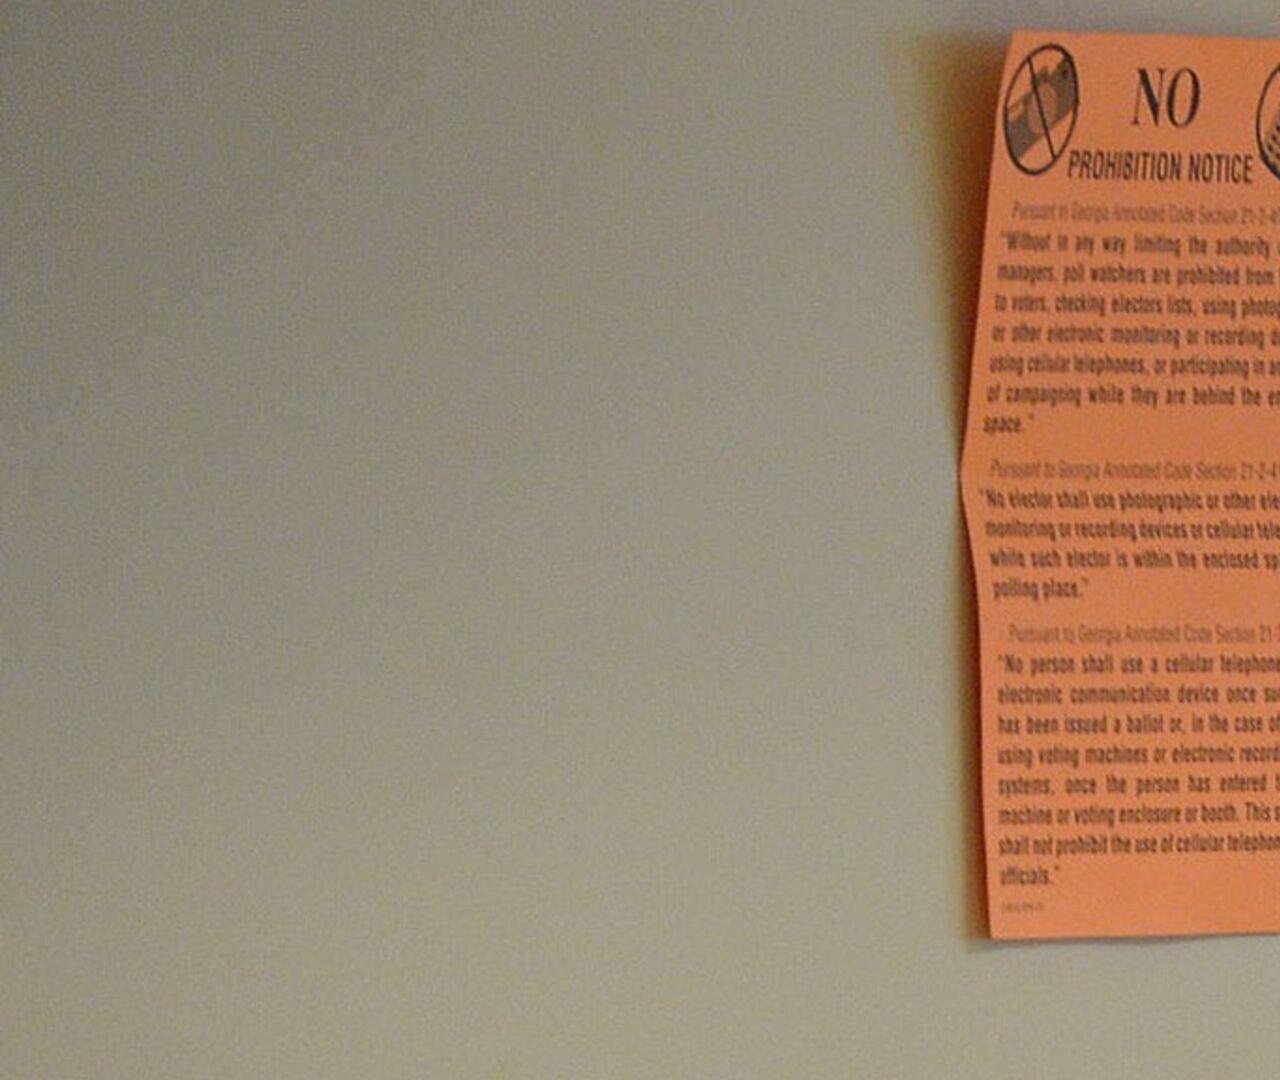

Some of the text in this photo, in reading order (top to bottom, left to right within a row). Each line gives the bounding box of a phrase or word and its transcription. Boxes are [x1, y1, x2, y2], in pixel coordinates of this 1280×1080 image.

[1131, 67, 1201, 127] NO
[1067, 150, 1253, 184] PROHIBITION NOTICE
[1031, 657, 1074, 676] person
[1082, 655, 1112, 672] shall
[1121, 658, 1143, 672] use
[1151, 659, 1158, 672] a
[1166, 655, 1213, 672] cellular
[1220, 654, 1280, 676] telephone
[998, 686, 1062, 703] electronic
[1071, 686, 1169, 703] communication
[1178, 686, 1218, 702] device
[1227, 689, 1255, 702] once
